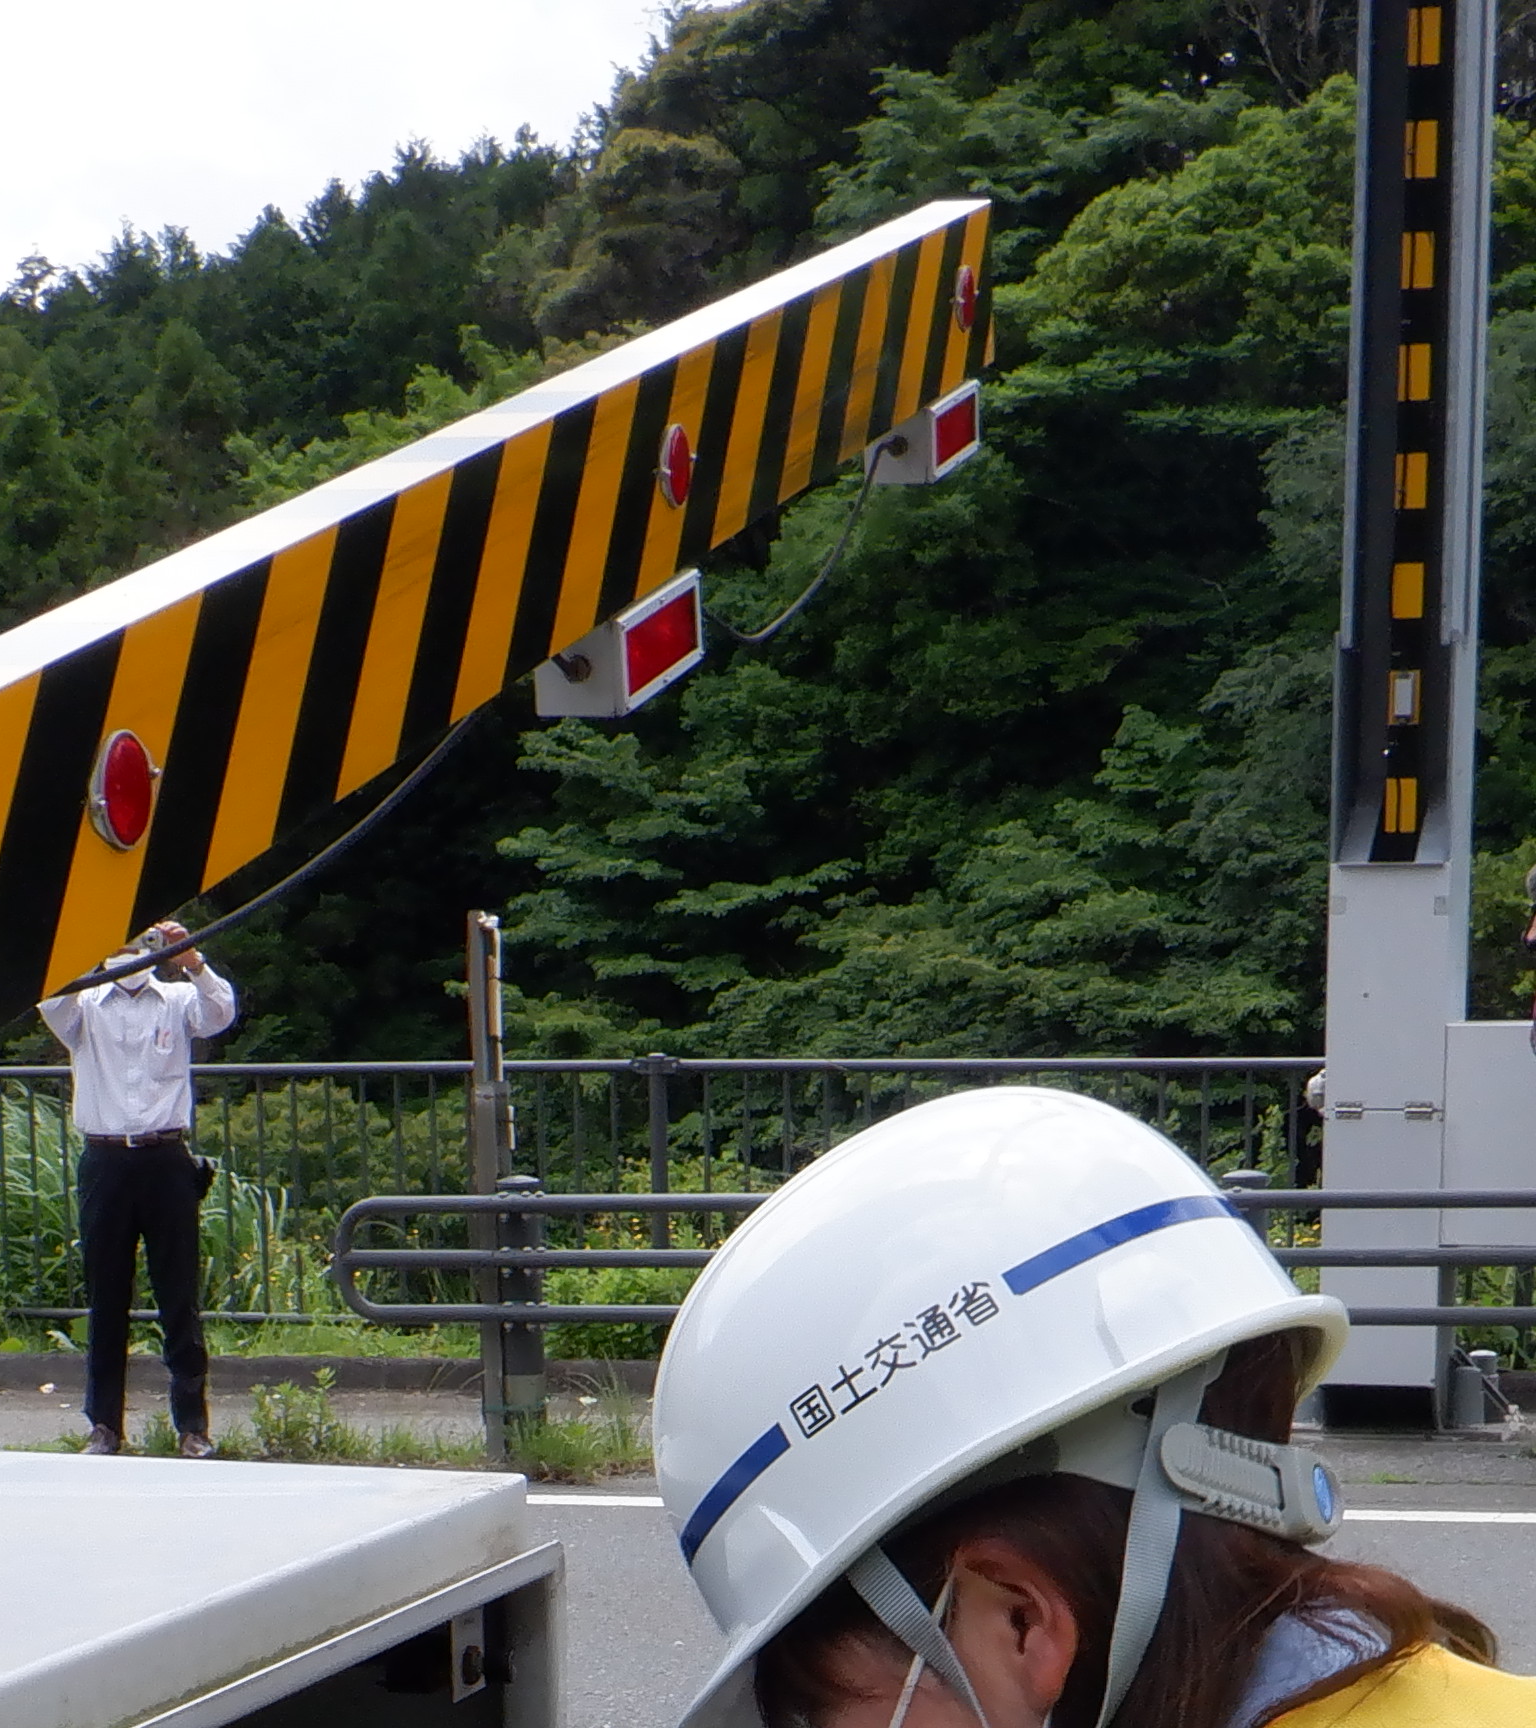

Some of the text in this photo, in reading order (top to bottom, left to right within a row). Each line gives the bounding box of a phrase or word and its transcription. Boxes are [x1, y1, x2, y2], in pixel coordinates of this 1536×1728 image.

[789, 1281, 1000, 1440] 国土交通省
